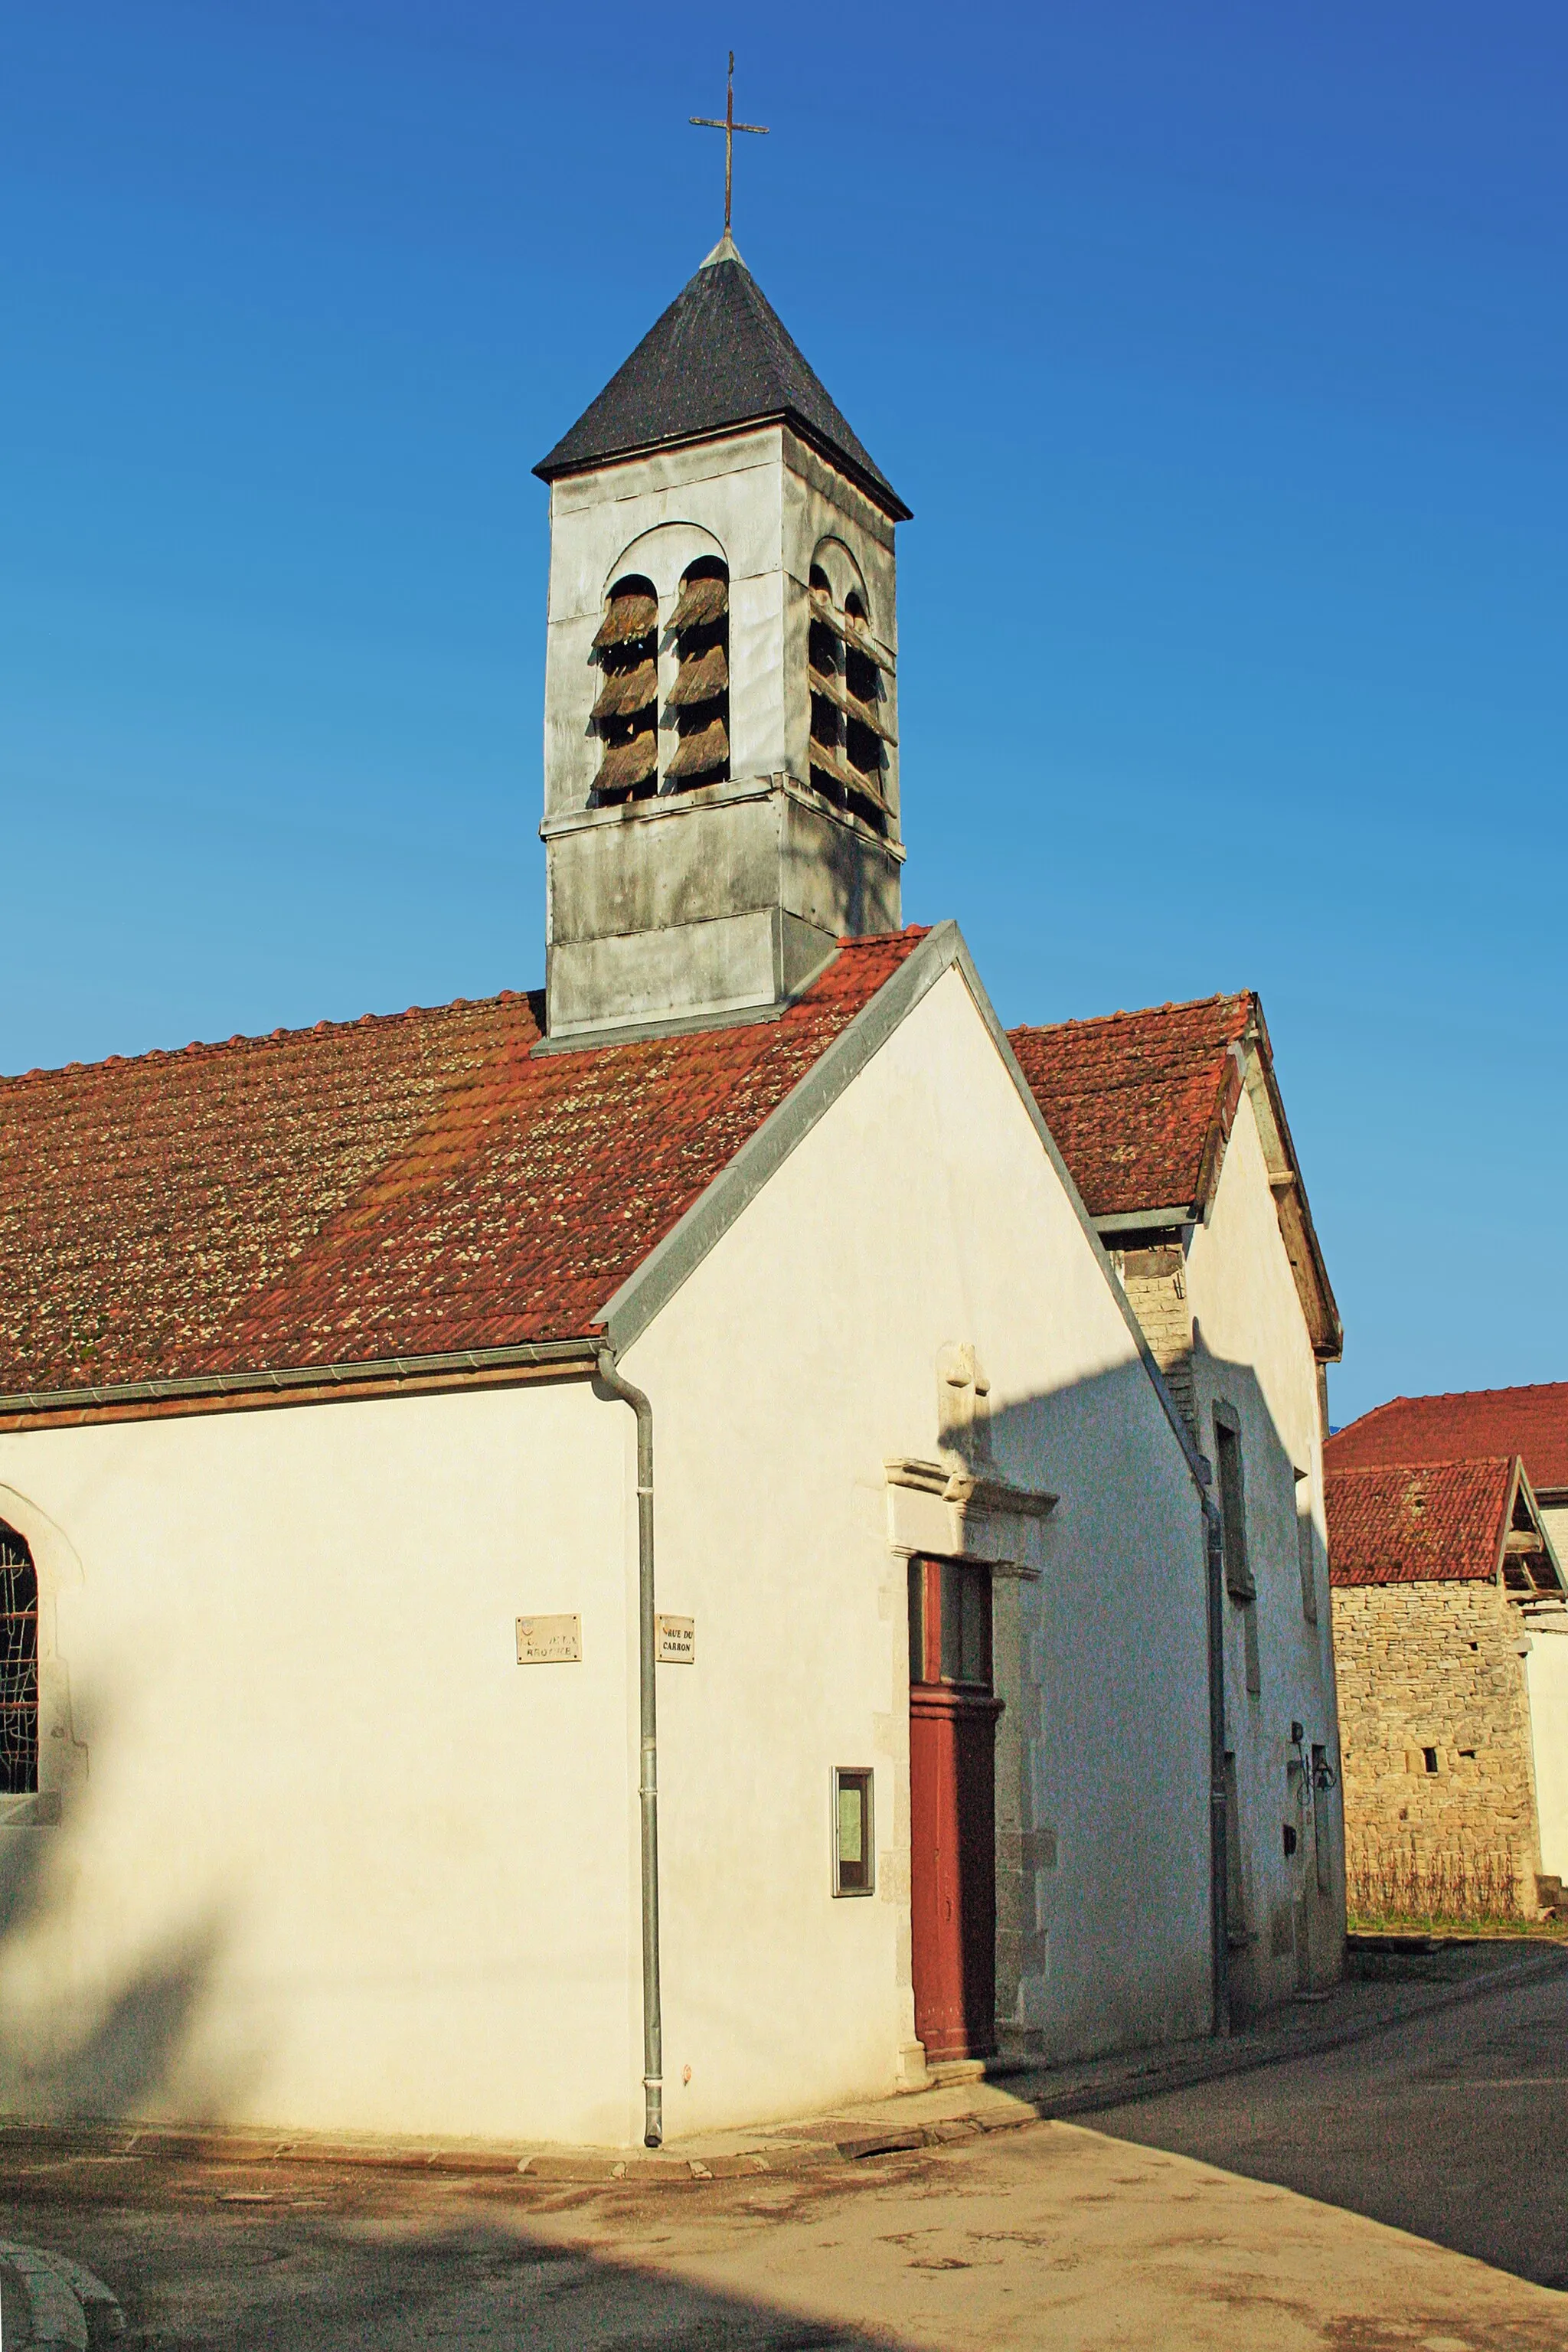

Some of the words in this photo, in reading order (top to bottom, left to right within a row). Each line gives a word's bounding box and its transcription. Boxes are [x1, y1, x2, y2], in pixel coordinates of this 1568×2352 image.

[668, 1629, 681, 1638] RUE
[684, 1630, 693, 1638] DU
[663, 1642, 691, 1651] CARRON
